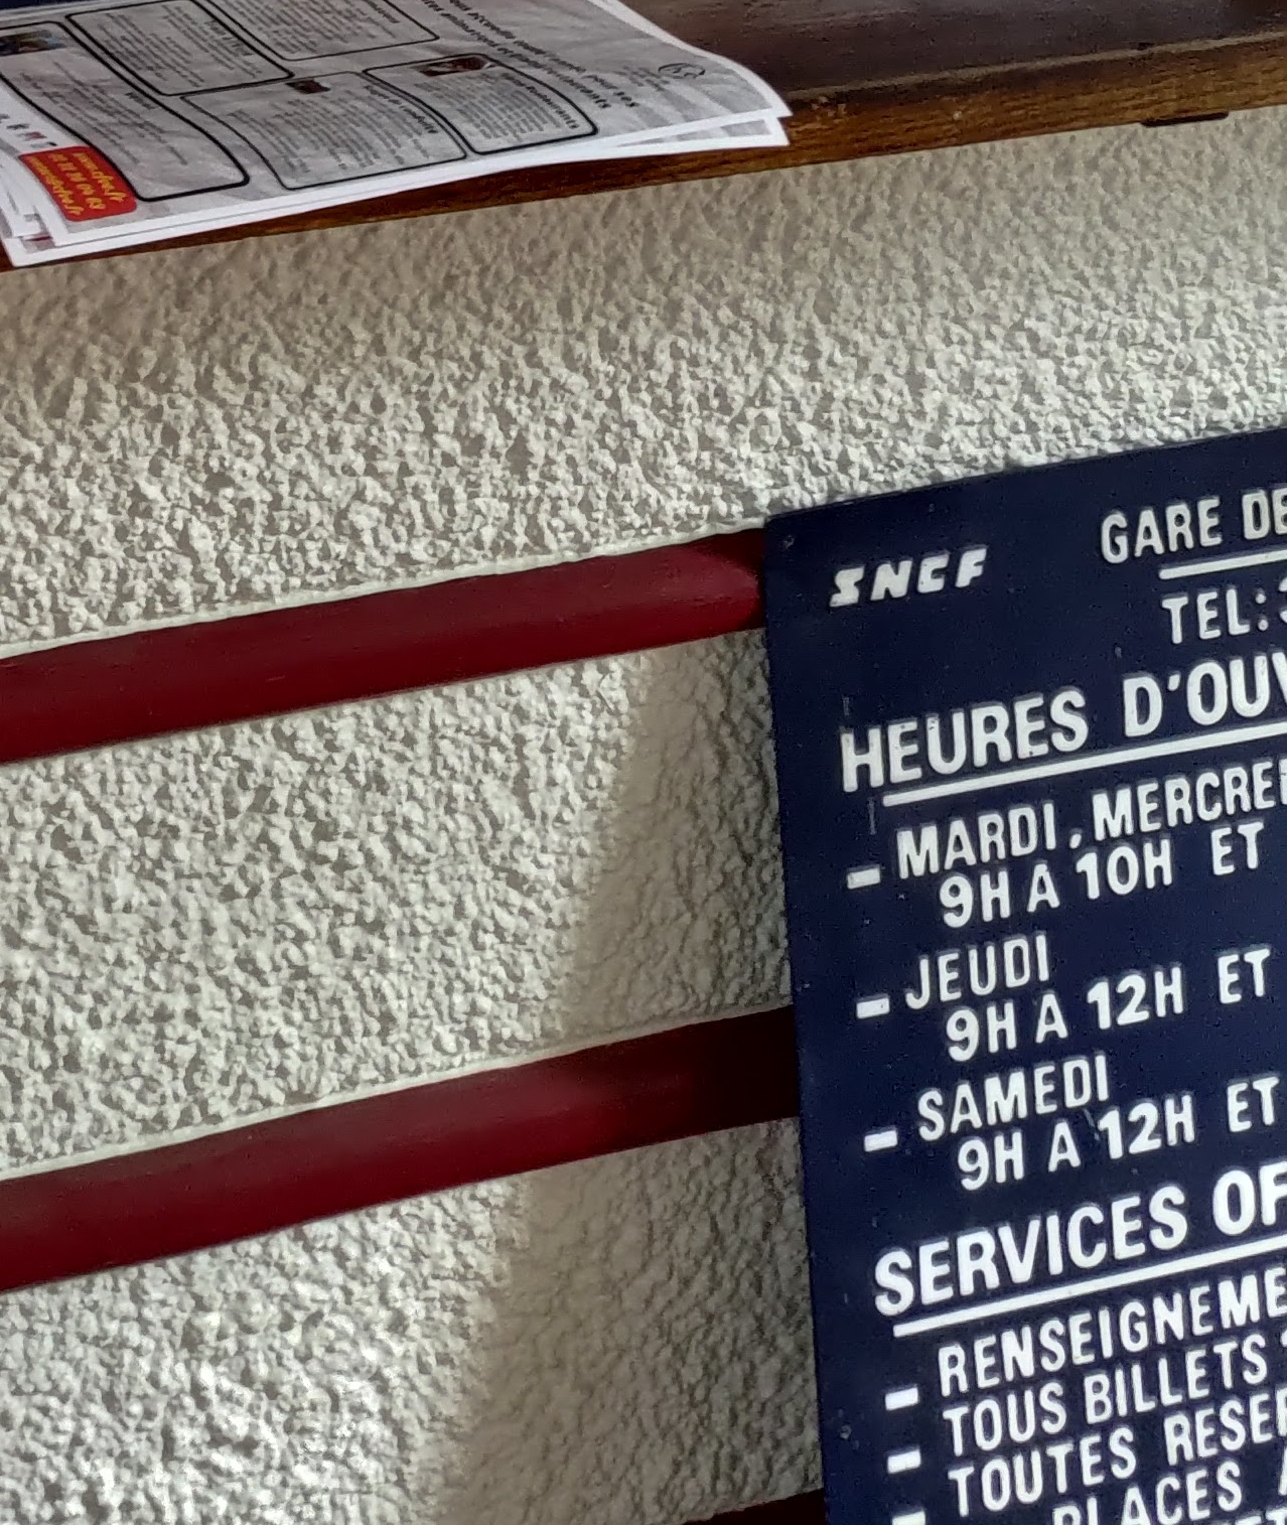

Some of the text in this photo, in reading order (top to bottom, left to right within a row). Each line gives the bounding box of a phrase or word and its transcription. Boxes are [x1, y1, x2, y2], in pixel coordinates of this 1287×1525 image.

[829, 547, 987, 608] SNCF
[1100, 487, 1287, 564] GARE DE
[839, 687, 1089, 793] HEURES
[939, 820, 1265, 928] 9H A 10H ET
[905, 933, 1050, 1010] JEUDI
[946, 948, 1271, 1062] 9H A 12H ET
[918, 1054, 1109, 1141] SAMEDI
[957, 1076, 1280, 1191] 9H A 12H ET
[875, 1160, 1287, 1316] SERVICES OF
[938, 1265, 1287, 1398] RENSEIGNEME
[942, 1333, 1268, 1457] TOUS BILLETS
[947, 1426, 1137, 1517] TOUTES
